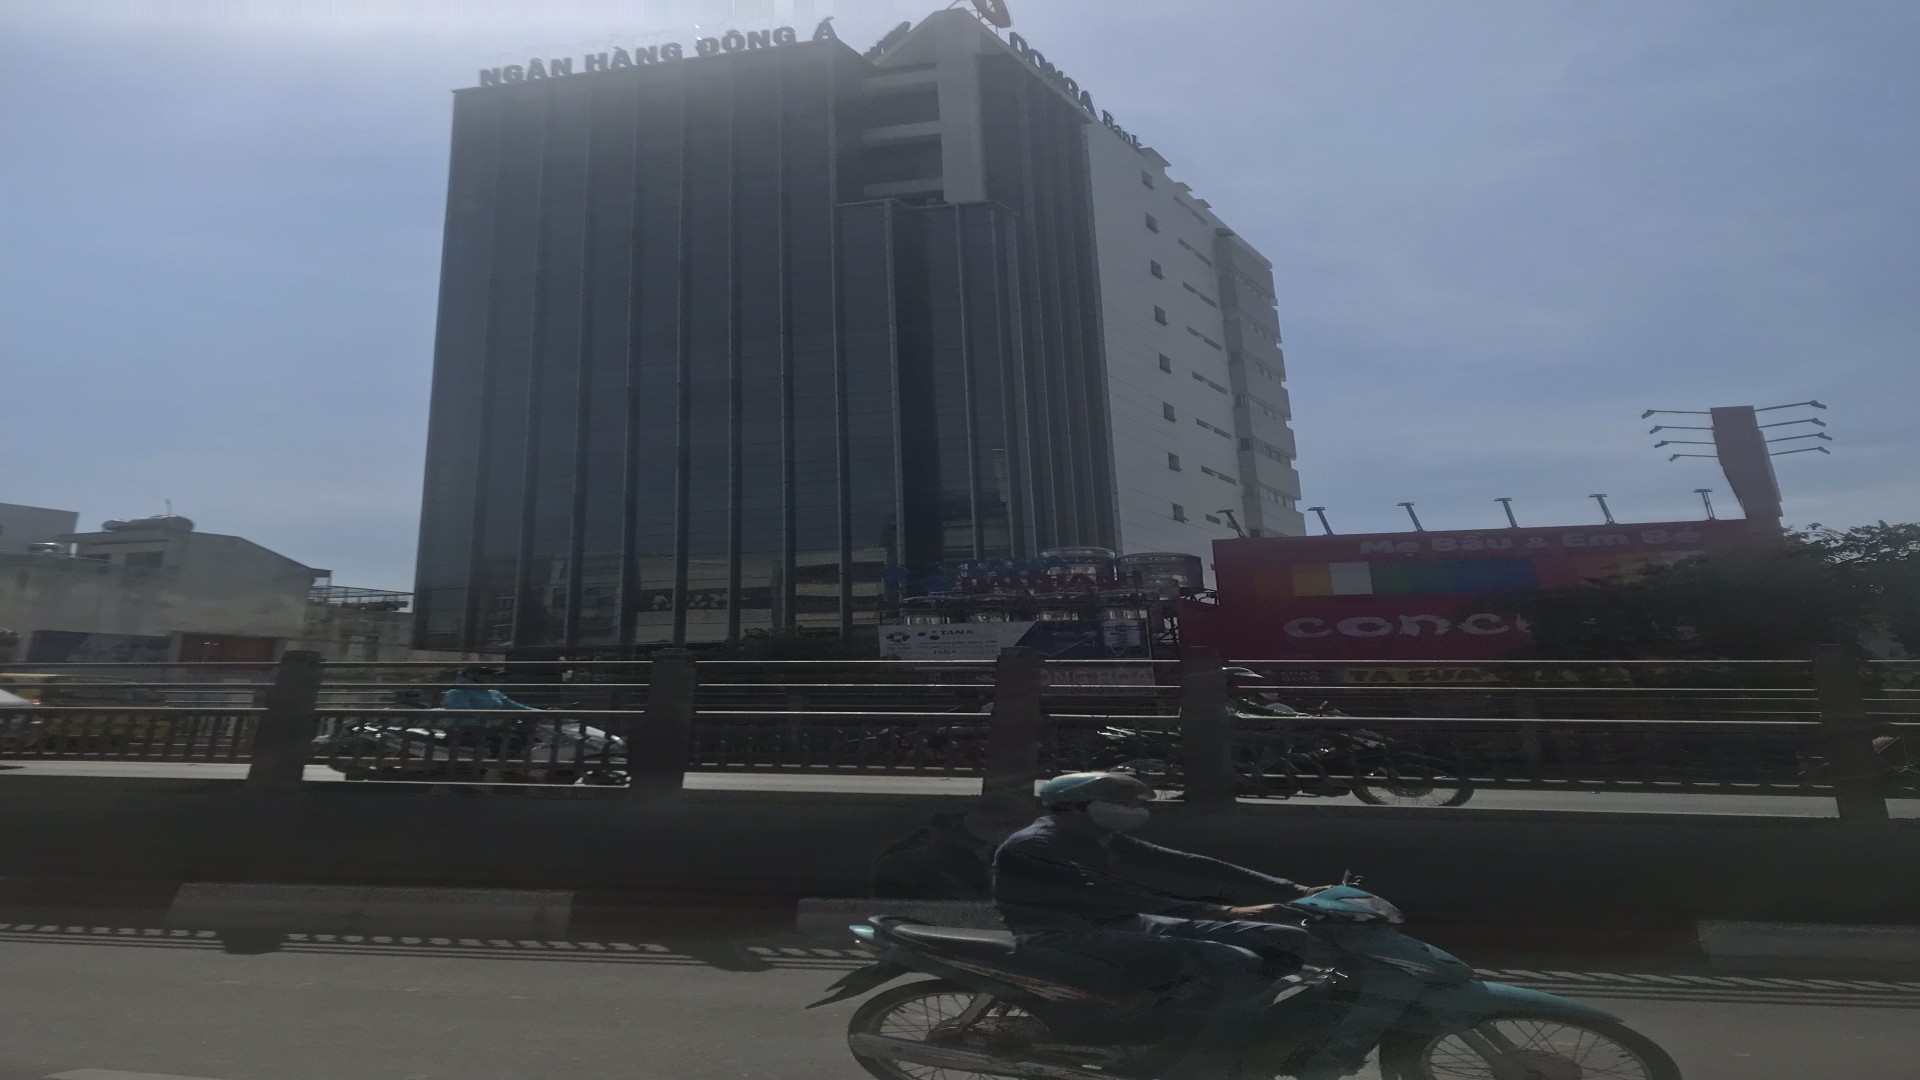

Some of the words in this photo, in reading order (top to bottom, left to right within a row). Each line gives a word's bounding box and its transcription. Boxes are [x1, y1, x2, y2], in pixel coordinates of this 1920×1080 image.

[478, 57, 573, 87] NGÂN
[585, 42, 683, 73] HÀNG
[812, 16, 839, 42] Á
[1360, 540, 1421, 557] Mẹ
[1431, 532, 1513, 552] Bầu
[1525, 536, 1551, 549] &
[1561, 533, 1630, 548] Em
[1641, 526, 1701, 545] Bé
